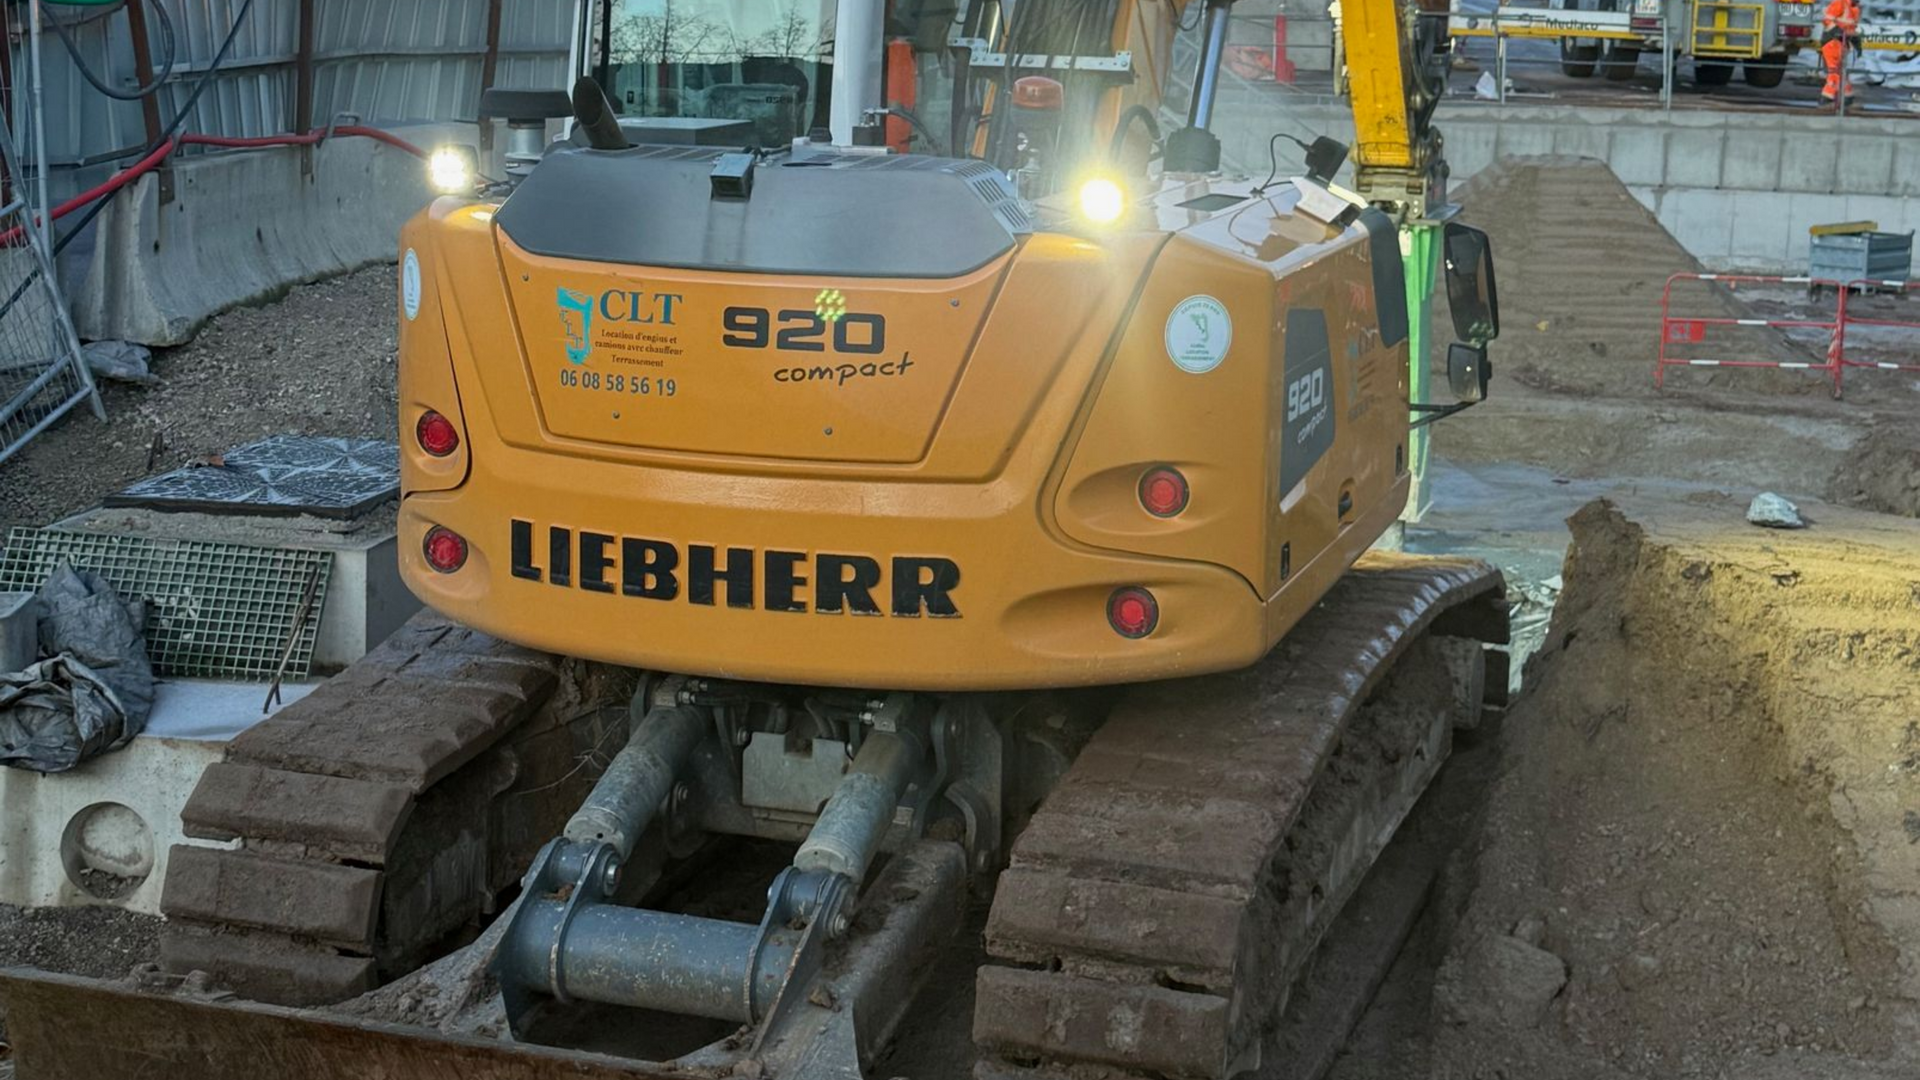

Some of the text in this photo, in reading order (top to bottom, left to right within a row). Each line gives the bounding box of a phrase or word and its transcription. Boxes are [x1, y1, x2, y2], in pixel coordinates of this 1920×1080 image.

[600, 289, 683, 325] CLT
[601, 329, 634, 341] Location
[669, 336, 678, 344] et
[722, 306, 886, 354] 920
[595, 340, 684, 356] camions avec chauffeur
[611, 354, 664, 367] Terrassement
[560, 369, 676, 396] 06 08 58 56 19
[774, 352, 915, 386] compact
[1287, 367, 1324, 424] 920
[1297, 398, 1328, 444] compact
[511, 517, 963, 619] LIEBHERR
